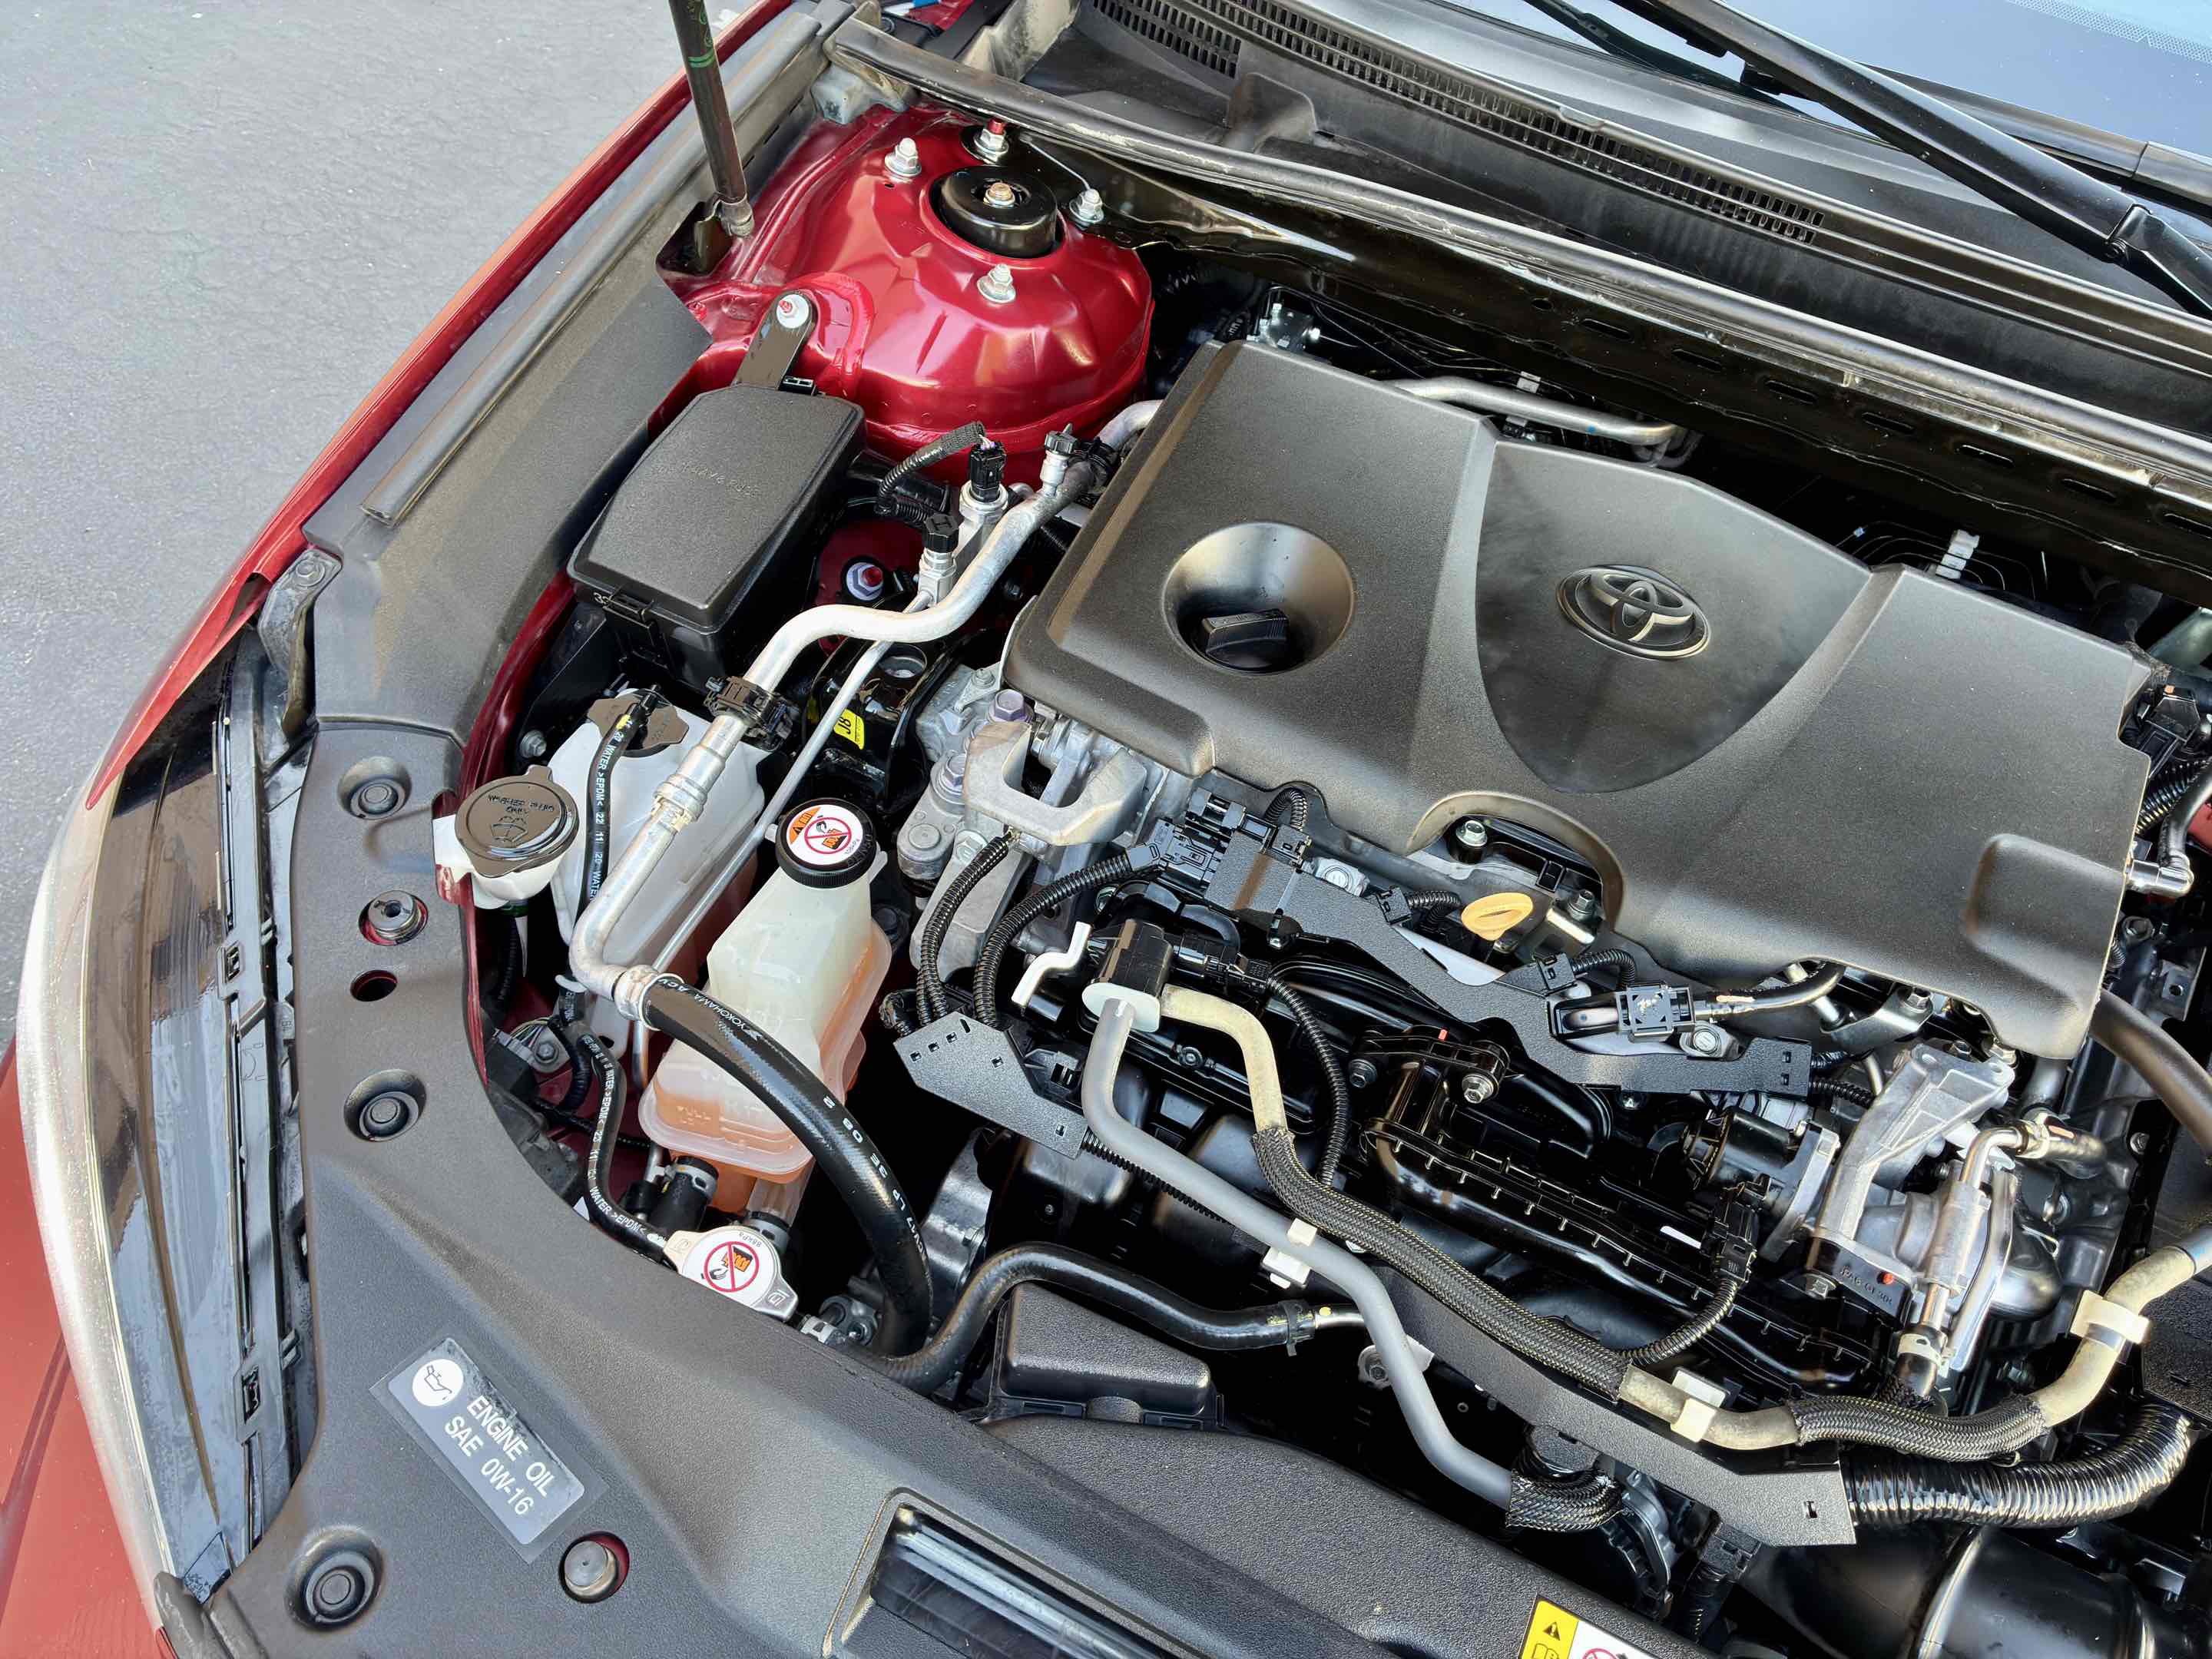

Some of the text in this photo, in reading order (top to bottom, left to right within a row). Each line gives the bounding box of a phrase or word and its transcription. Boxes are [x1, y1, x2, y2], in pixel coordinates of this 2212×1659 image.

[597, 743, 618, 770] WATER
[595, 813, 605, 824] 22
[694, 993, 747, 1030] YOKOHAMA
[605, 1068, 615, 1089] WATER
[589, 1186, 611, 1213] WATER
[892, 1189, 906, 1210] LP
[466, 1394, 558, 1497] ENGINE OIL
[443, 1416, 535, 1516] SAE 0W-16
